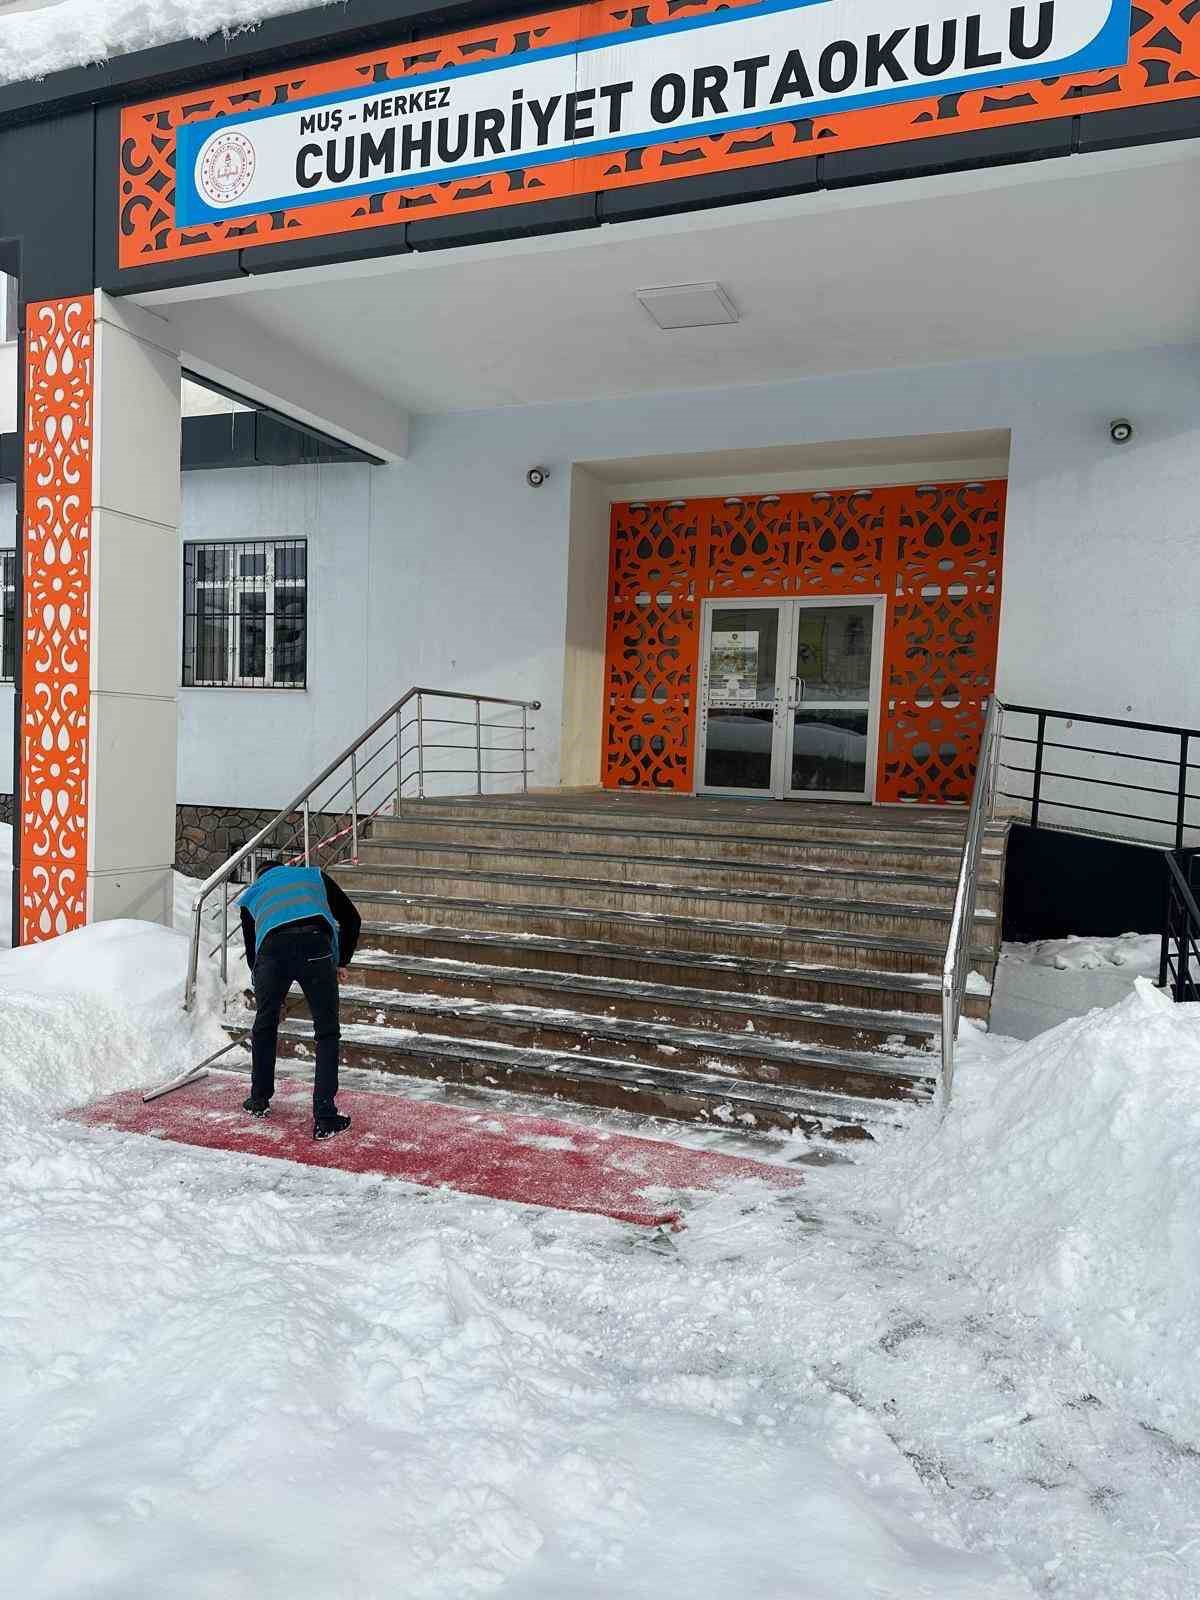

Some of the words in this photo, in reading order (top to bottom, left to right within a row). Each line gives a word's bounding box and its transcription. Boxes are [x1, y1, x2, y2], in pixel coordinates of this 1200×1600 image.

[295, 82, 633, 189] CUMHURİYET
[650, 1, 1055, 124] ORTAOKULU
[300, 109, 343, 136] MUŞ
[362, 86, 451, 123] MERKEZ
